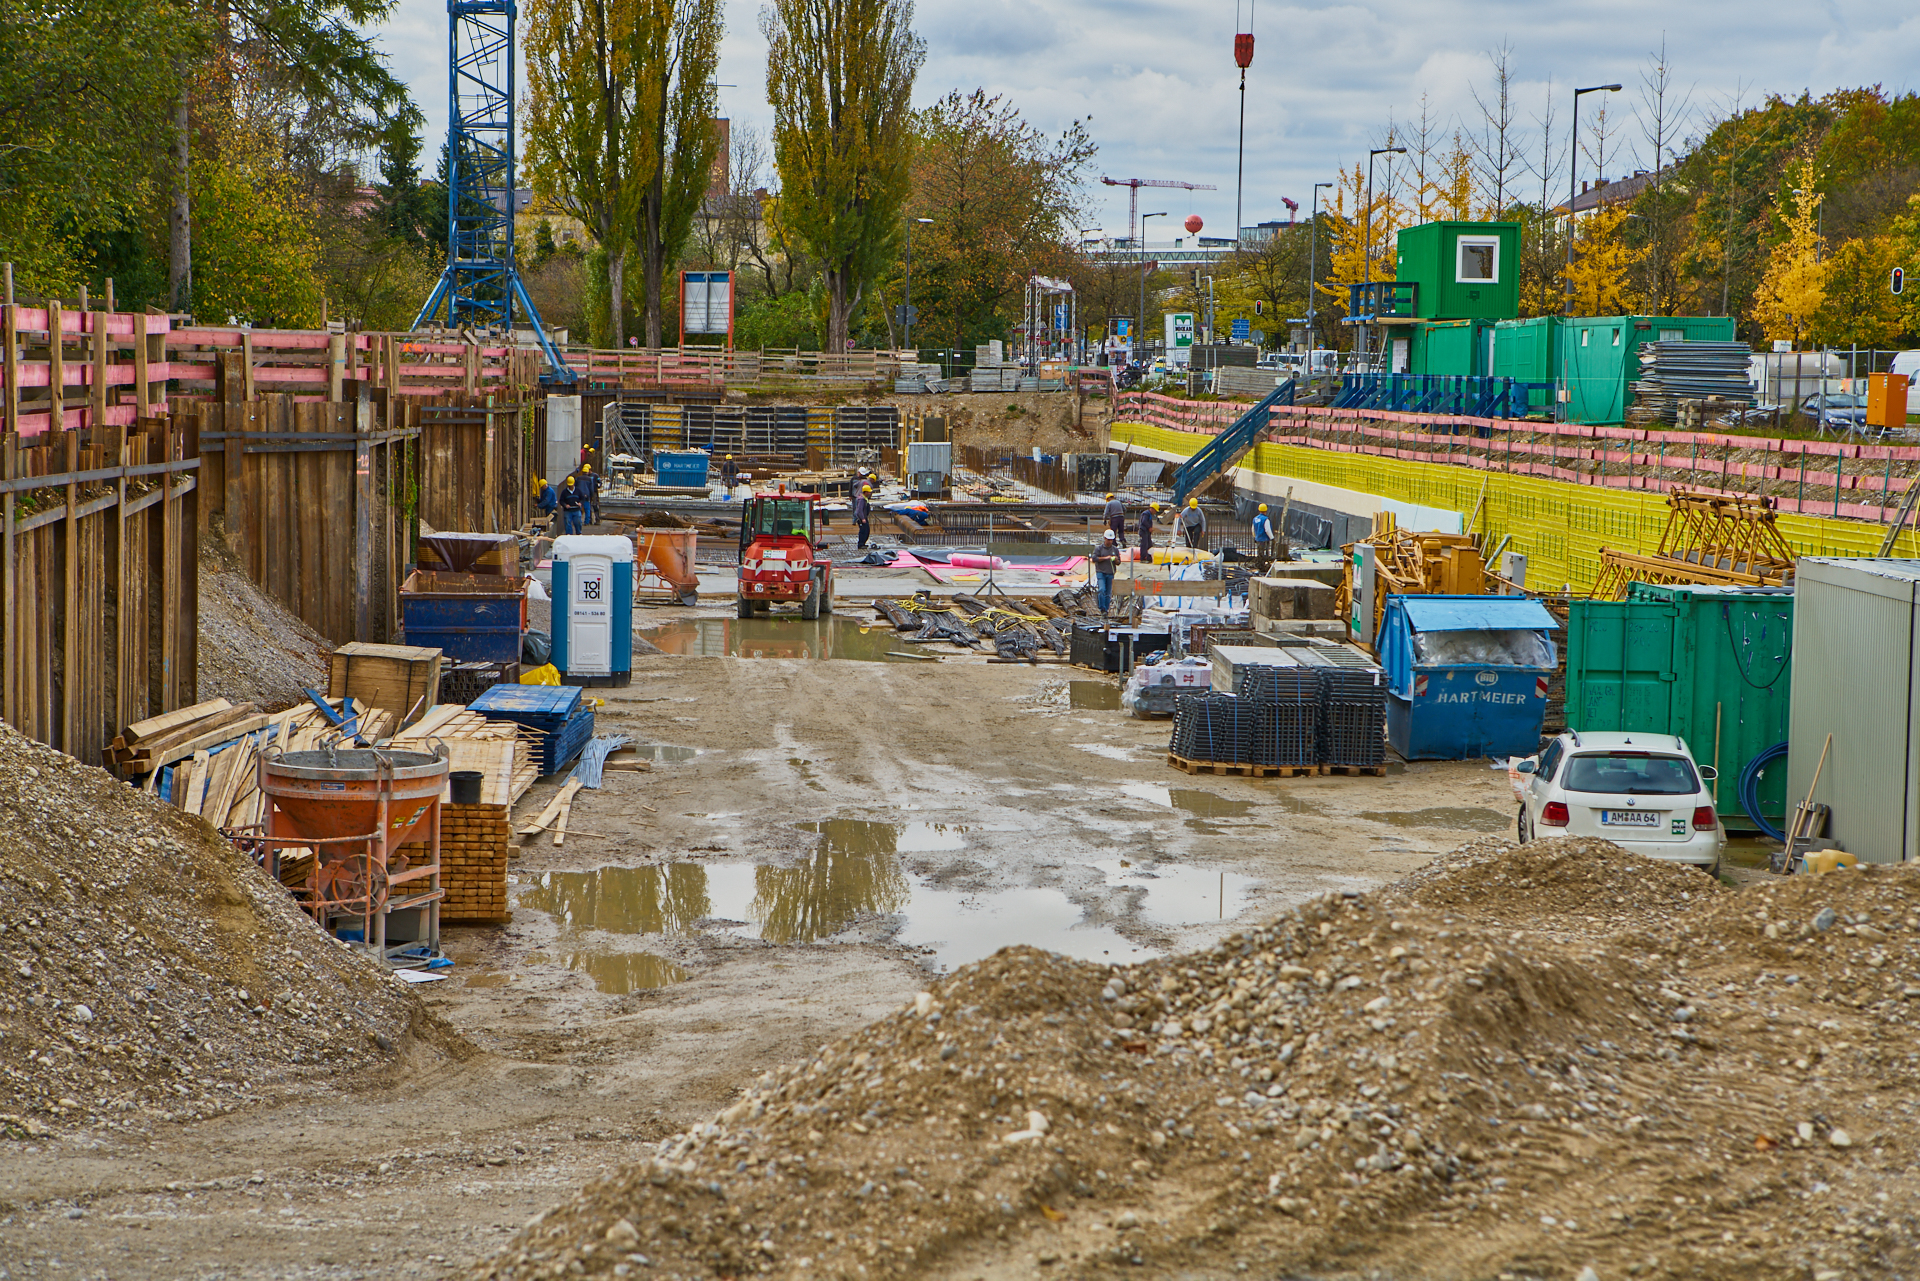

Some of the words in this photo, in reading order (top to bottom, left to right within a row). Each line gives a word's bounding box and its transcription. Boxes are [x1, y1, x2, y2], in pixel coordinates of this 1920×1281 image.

[583, 590, 600, 599] TOI
[1438, 691, 1526, 704] HARTMEIER
[1611, 812, 1623, 822] AM
[1630, 813, 1642, 822] AA
[1644, 813, 1655, 823] 64
